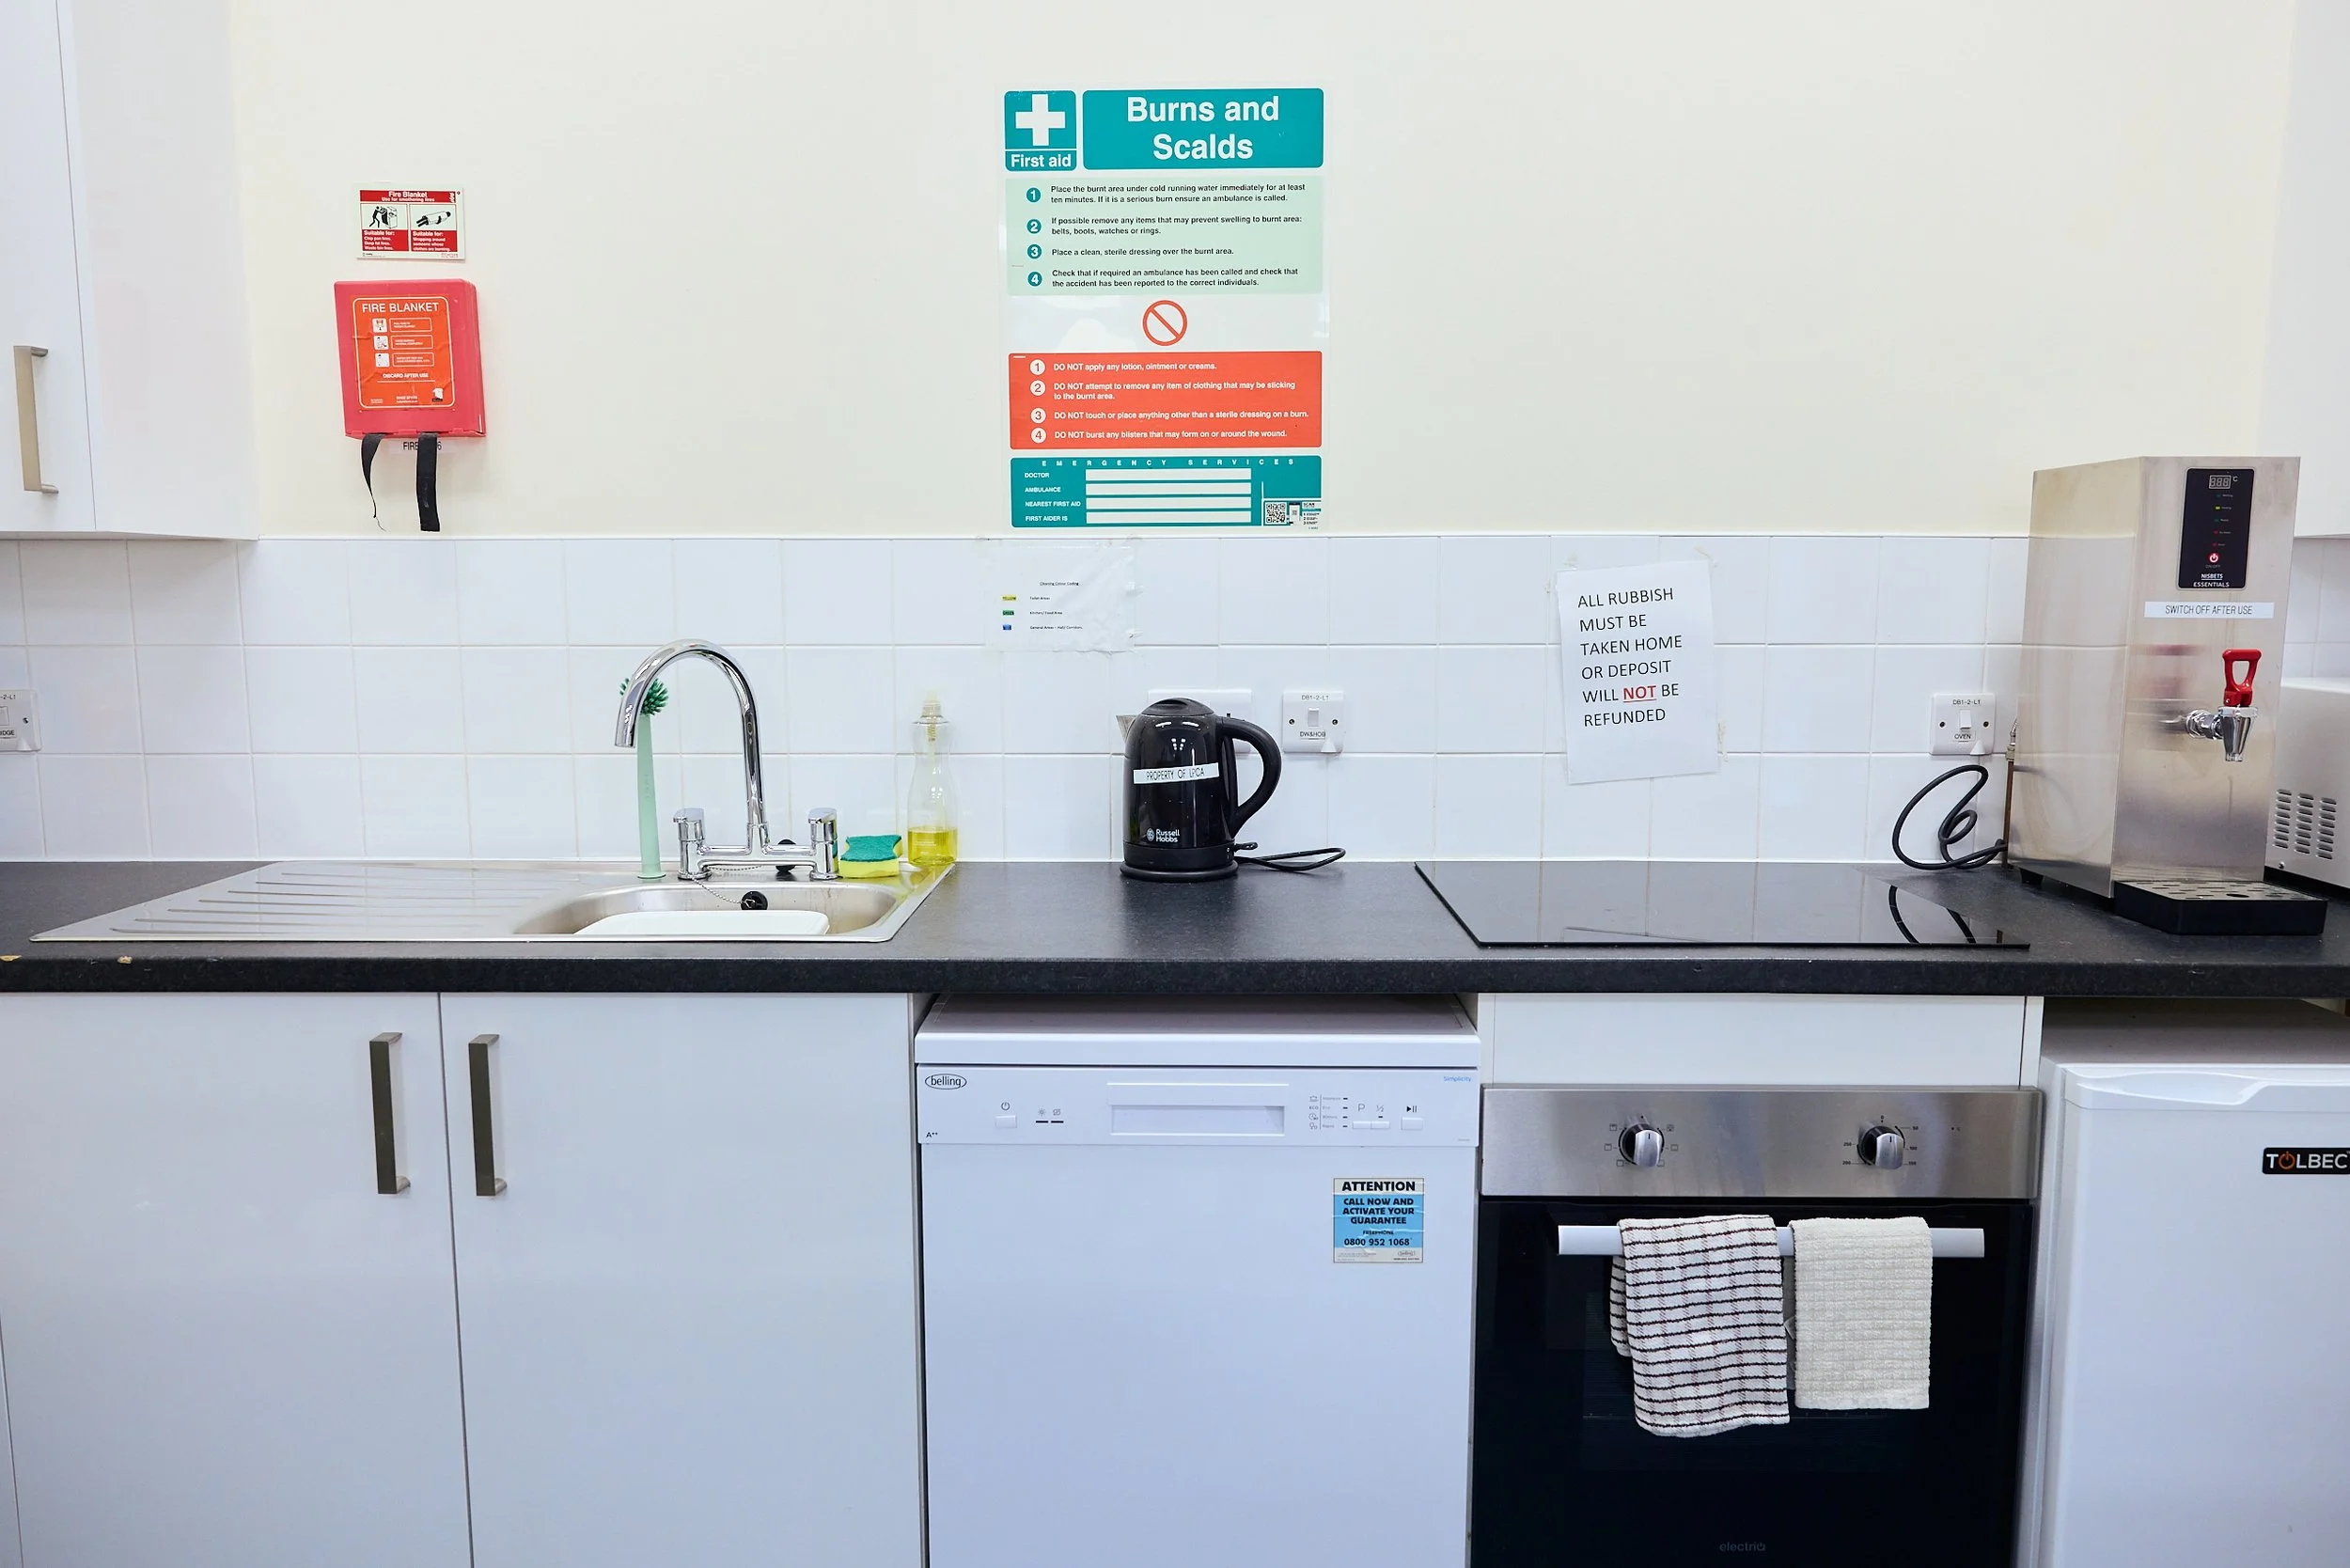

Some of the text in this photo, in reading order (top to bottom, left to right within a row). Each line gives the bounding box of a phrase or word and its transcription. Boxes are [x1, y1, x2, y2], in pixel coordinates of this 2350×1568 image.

[1127, 95, 1278, 122] Burns and
[1153, 133, 1253, 160] Scalds
[1010, 153, 1071, 167] First aid
[362, 302, 438, 312] FIRE BLANKET
[1085, 363, 1104, 371] apply
[1577, 587, 1672, 607] ALL RUBBISH
[2165, 604, 2252, 614] SWITCH OFF AFTER USE
[1580, 614, 1646, 632] MUST BE
[1580, 635, 1682, 655] TAKEN HOME
[1581, 660, 1670, 680] OR DEPOSIT
[1582, 682, 1678, 703] WILL NOT BE
[1584, 708, 1665, 727] REFUNDED
[1146, 769, 1174, 781] PROPERTY
[1177, 769, 1186, 779] OF
[931, 1075, 962, 1088] belling
[2265, 1151, 2348, 1169] TOLBEC
[1341, 1181, 1415, 1191] ATTENTION
